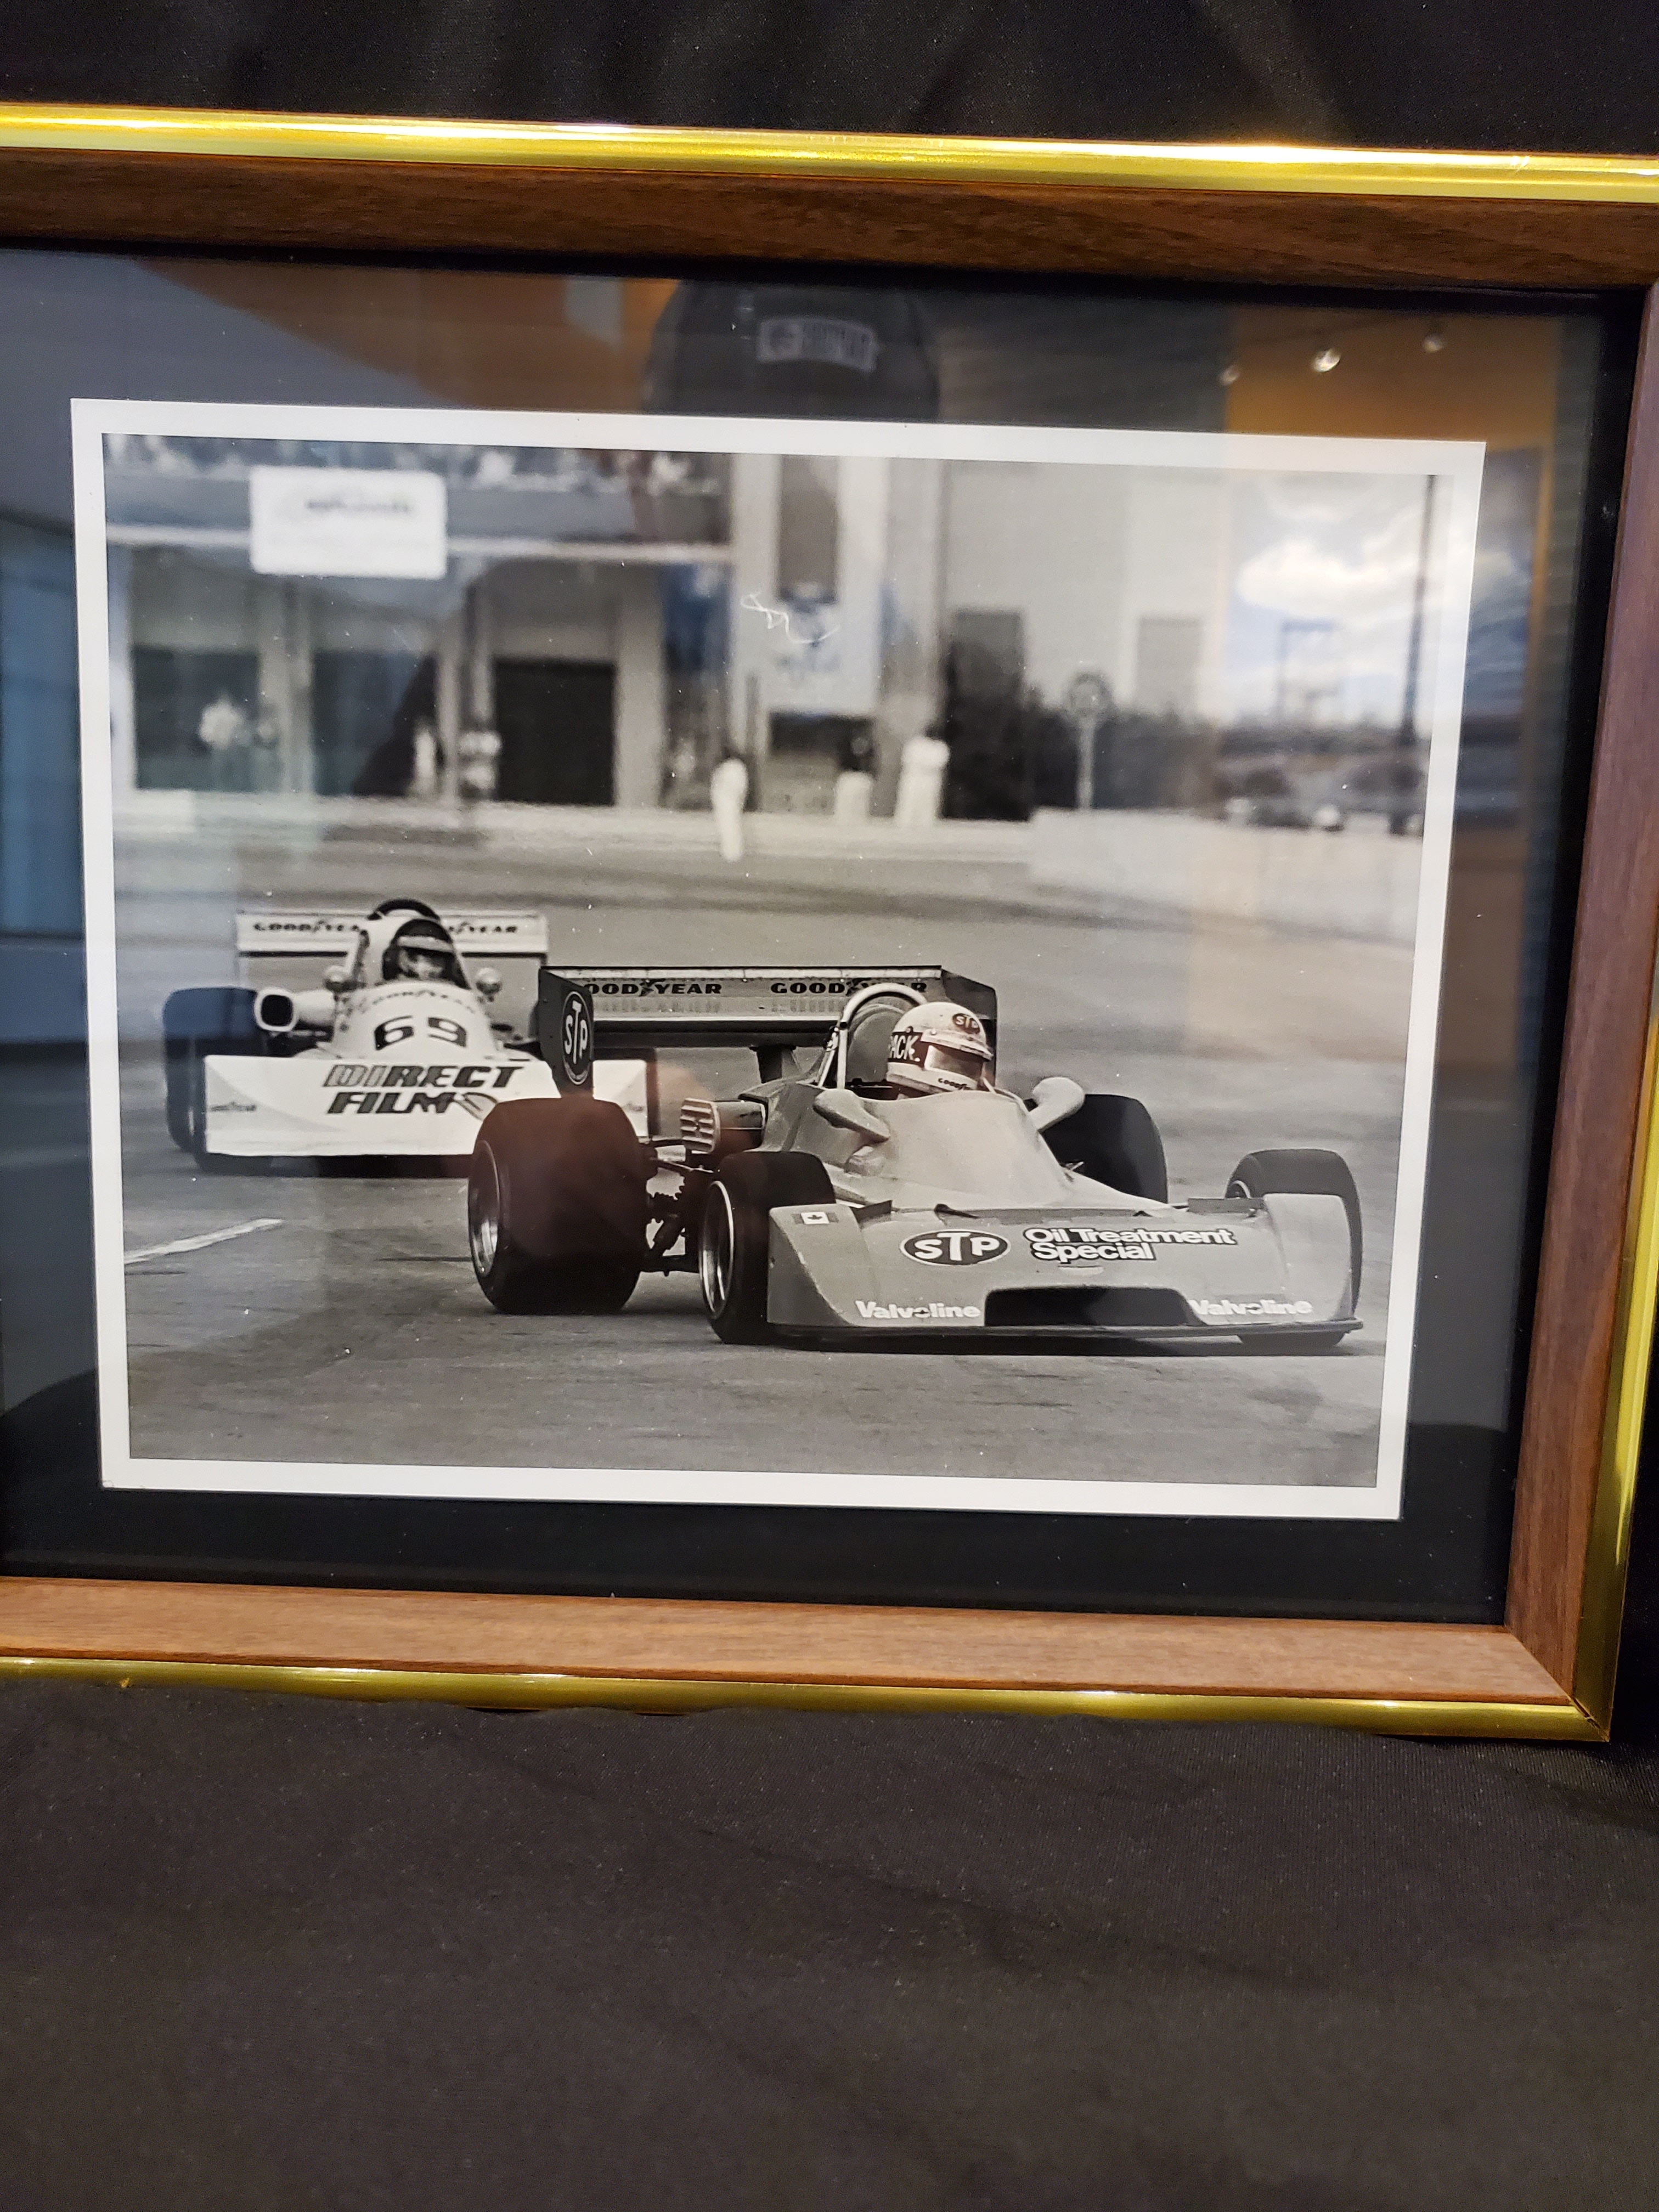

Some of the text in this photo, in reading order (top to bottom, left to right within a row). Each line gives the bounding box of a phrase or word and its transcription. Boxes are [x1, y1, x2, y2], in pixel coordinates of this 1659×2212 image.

[584, 983, 721, 996] OODYEAR
[374, 1015, 467, 1051] 69
[564, 1000, 588, 1065] STP
[323, 1065, 524, 1087] DIRECT
[915, 1232, 1000, 1261] STP
[1026, 1229, 1234, 1244] Oil Treatment
[1034, 1242, 1154, 1262] Special
[855, 1300, 981, 1318] Valvoline
[1188, 1299, 1313, 1315] Valvoline
